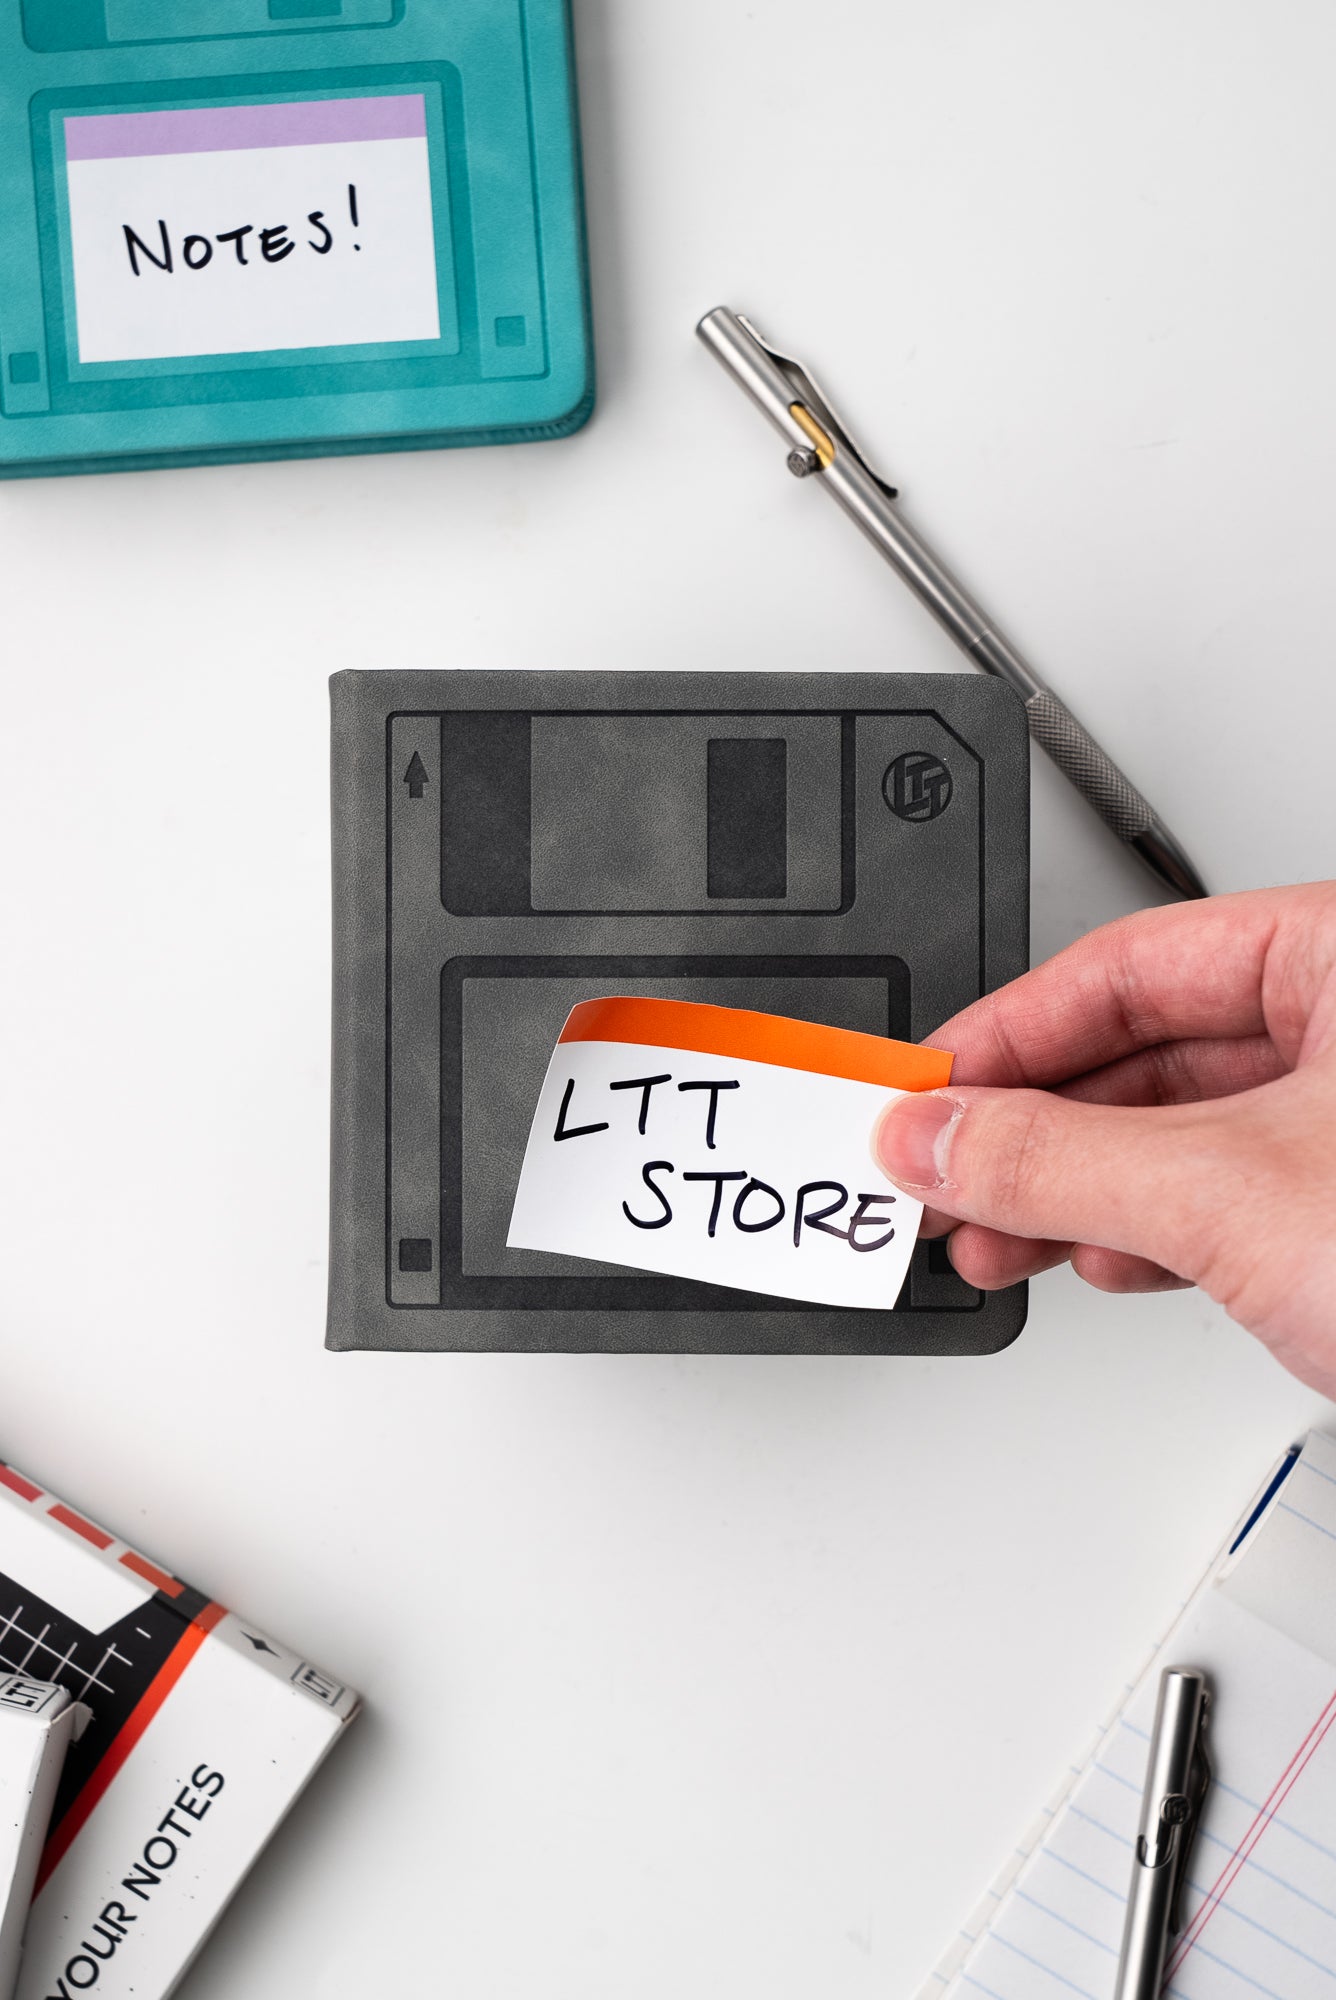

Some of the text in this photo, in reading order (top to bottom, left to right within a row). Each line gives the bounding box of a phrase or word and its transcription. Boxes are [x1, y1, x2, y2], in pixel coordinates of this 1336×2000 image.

[882, 751, 953, 823] LTT
[554, 1074, 741, 1150] LTT
[622, 1160, 897, 1252] STORE
[0, 1681, 46, 1708] LTT
[121, 1763, 225, 1901] NOTES
